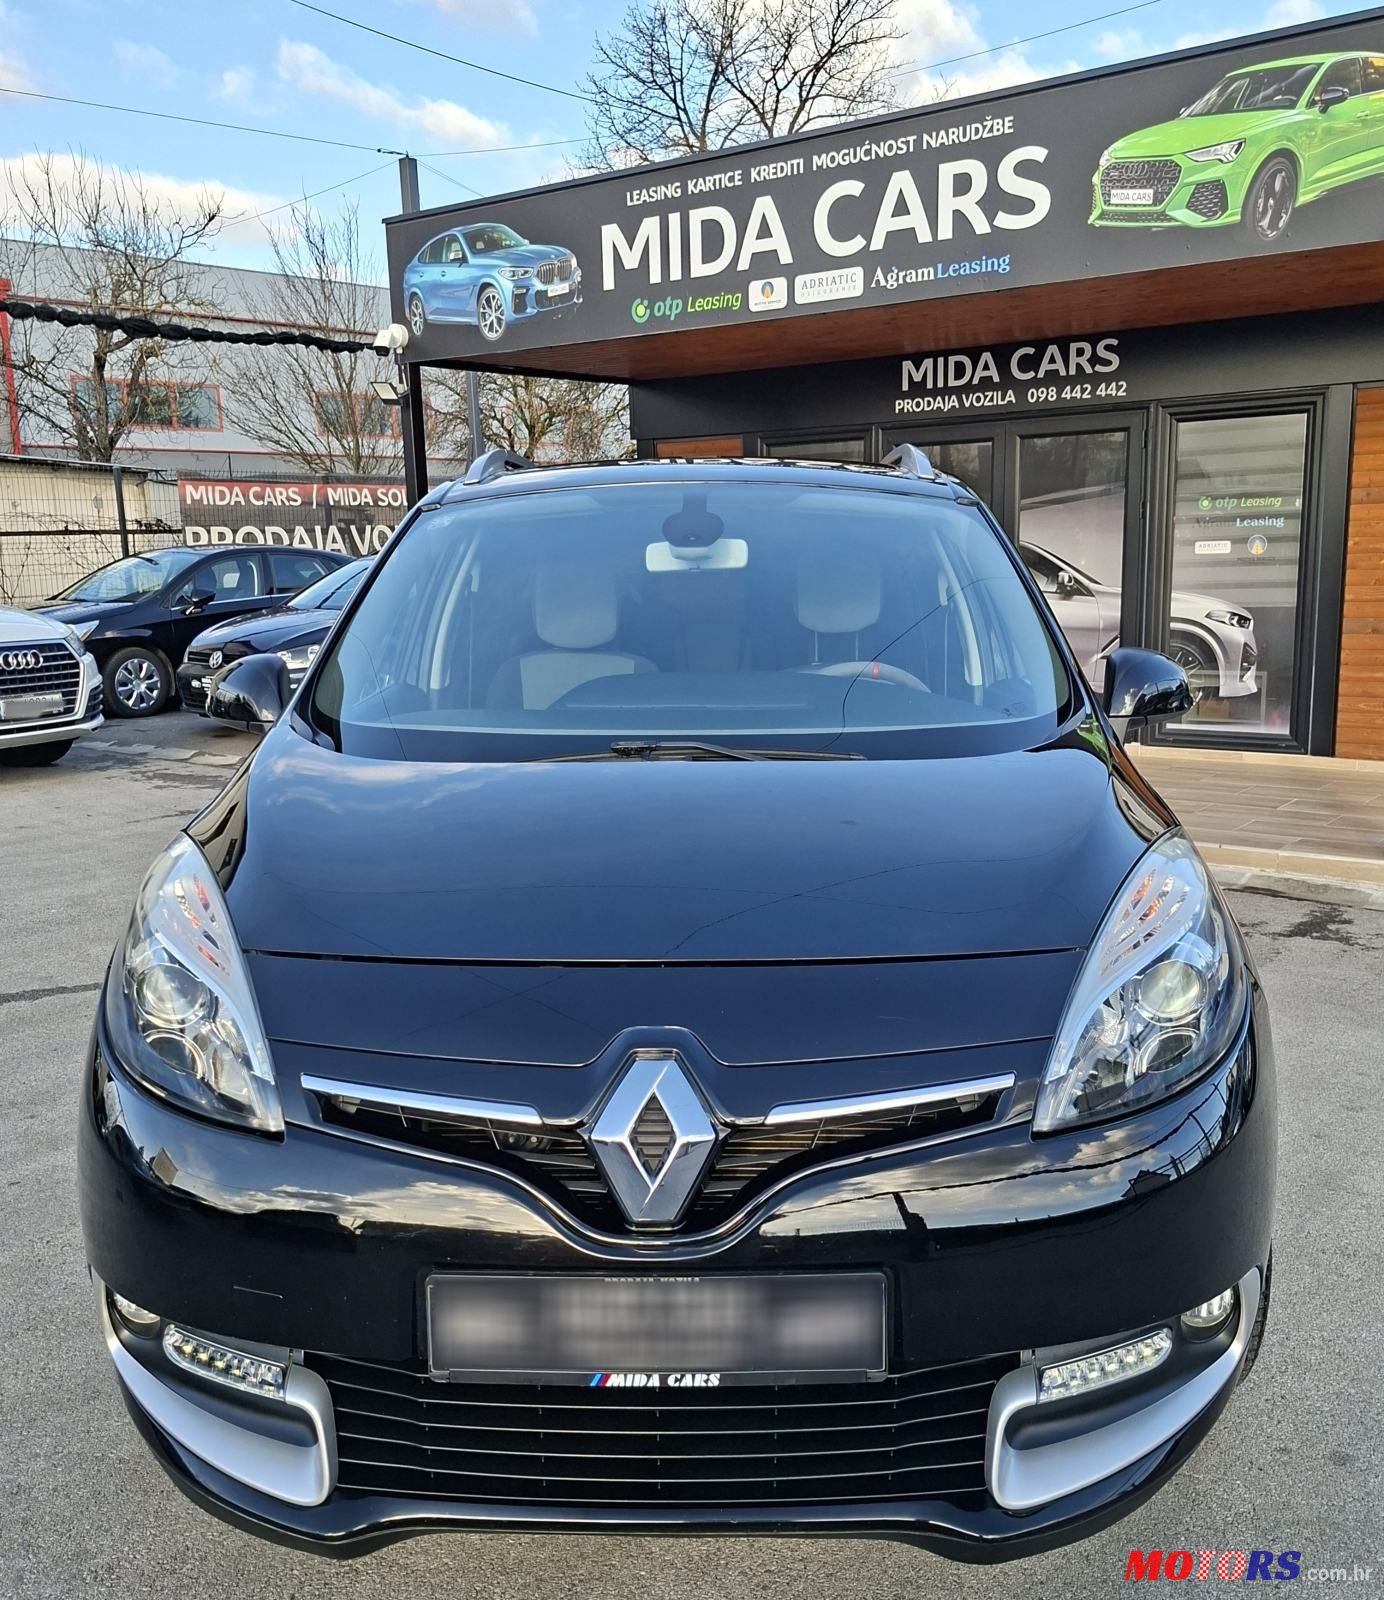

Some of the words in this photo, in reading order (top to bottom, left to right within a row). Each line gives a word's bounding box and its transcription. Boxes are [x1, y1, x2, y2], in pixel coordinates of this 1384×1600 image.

[626, 182, 682, 206] LEASING
[687, 170, 743, 195] KARTICE
[750, 158, 804, 183] KREDITI
[812, 136, 917, 171] MOGUĆNOST
[922, 115, 1015, 150] NARUDŽBE
[1112, 191, 1130, 201] MIDA
[1132, 191, 1152, 201] CARS
[601, 195, 794, 291] MIDA
[812, 145, 1052, 258] CARS
[801, 272, 857, 290] ADRIATIC
[653, 296, 683, 320] otp
[687, 292, 742, 313] Leasing
[901, 351, 1000, 391] MIDA
[1009, 338, 1120, 380] CARS
[895, 393, 959, 414] PRODAJA
[962, 389, 1016, 408] VOZILA
[1027, 386, 1057, 403] 098
[1061, 383, 1092, 399] 442
[1095, 381, 1127, 397] 442
[185, 484, 245, 506] MIDA
[249, 486, 302, 507] CARS
[327, 487, 374, 506] MIDA
[1215, 496, 1237, 510] otp
[1240, 496, 1282, 508] Leasing
[605, 1373, 660, 1387] MIDA
[667, 1373, 720, 1387] CARS
